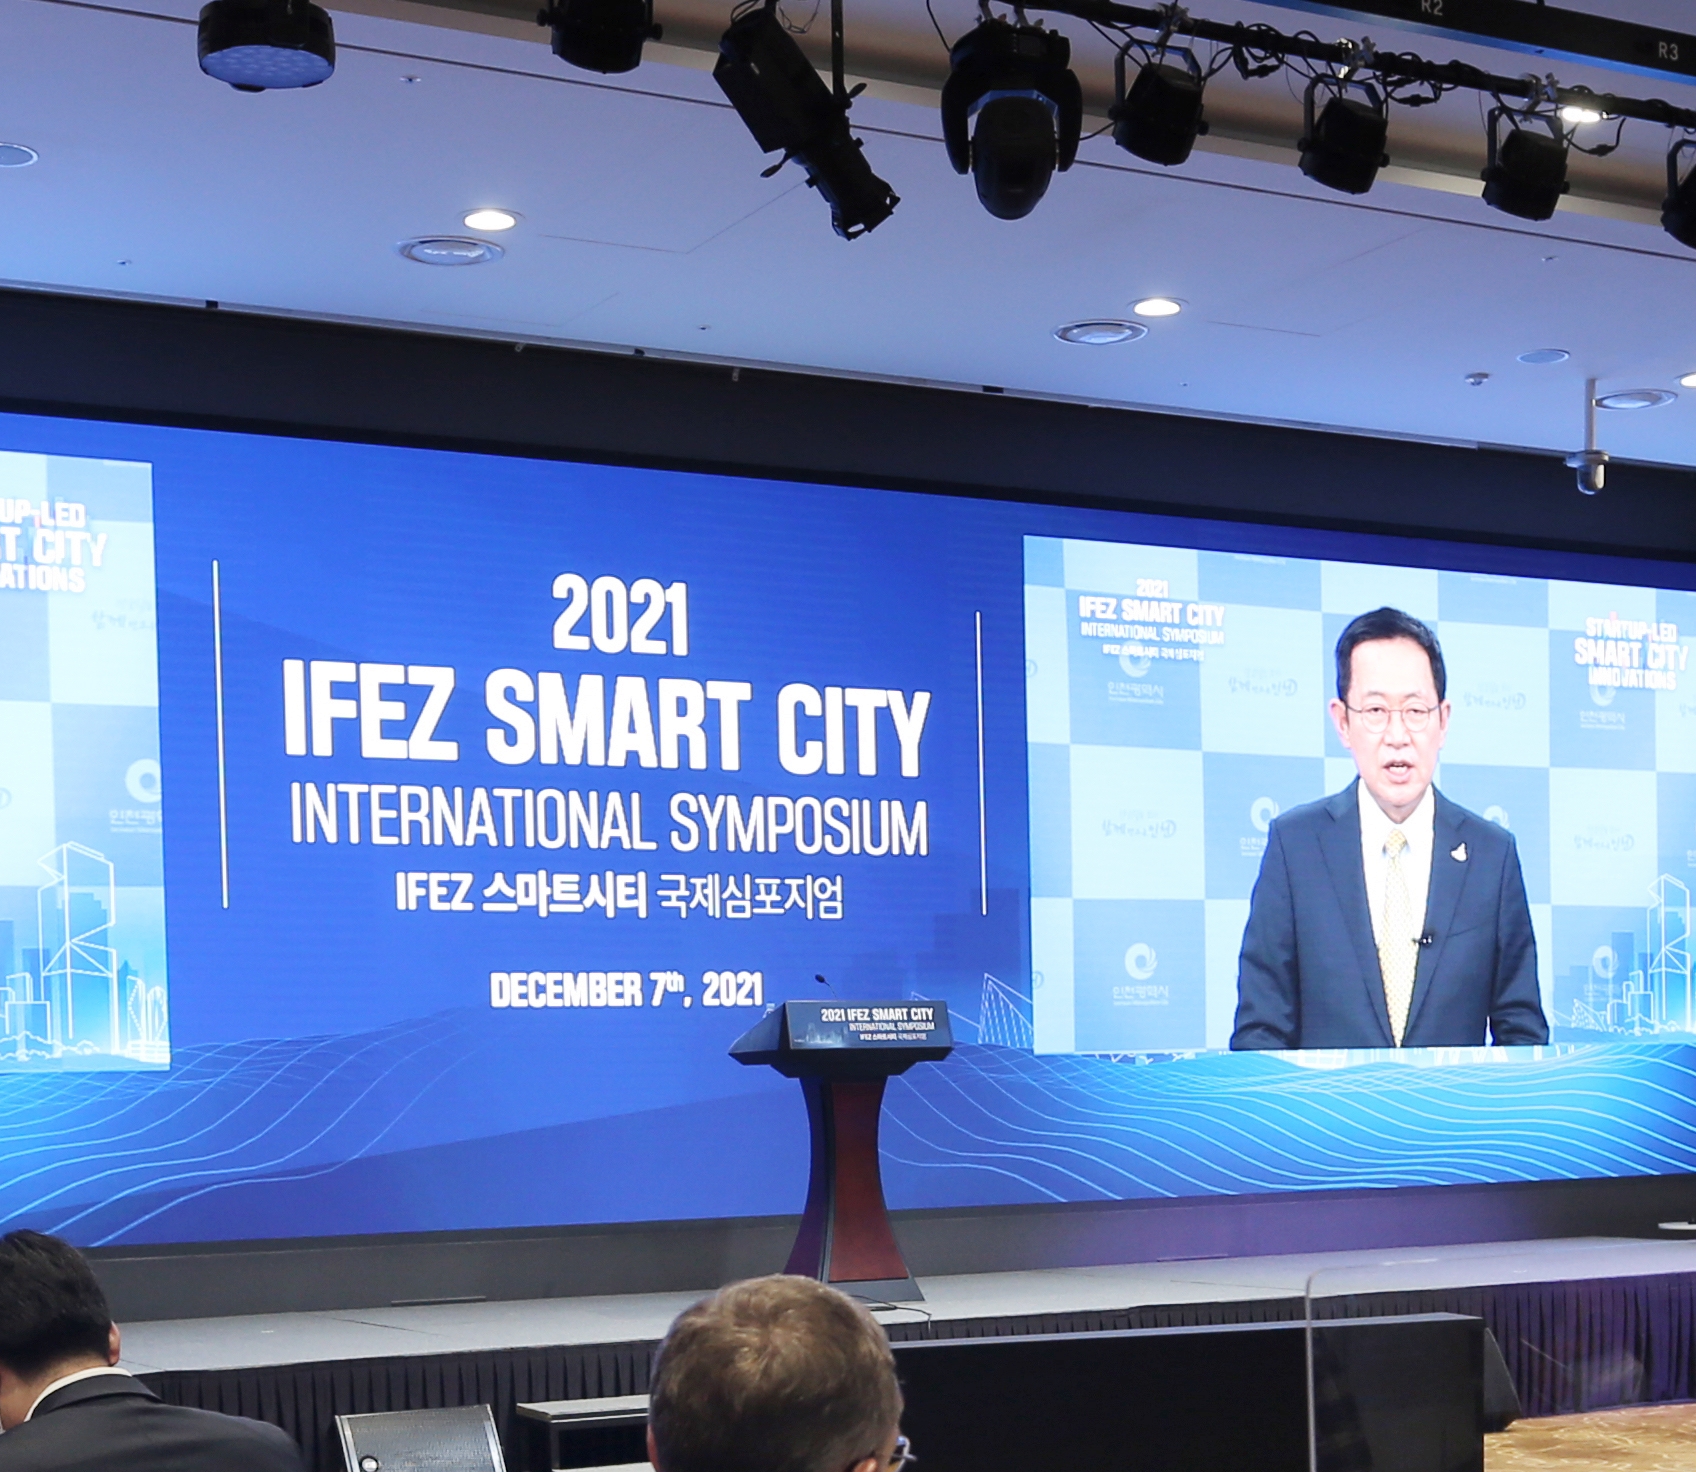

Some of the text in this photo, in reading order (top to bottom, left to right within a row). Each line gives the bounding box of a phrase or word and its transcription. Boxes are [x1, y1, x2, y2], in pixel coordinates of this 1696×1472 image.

[1421, 0, 1443, 16] R2
[1658, 41, 1679, 60] R3
[33, 528, 107, 566] CITY
[1135, 578, 1169, 598] 2021
[551, 572, 689, 657] 2021
[1078, 595, 1225, 627] IFEZ SMART CITY
[1080, 621, 1225, 645] INTERNATIONAL SYMPOSIUM
[1585, 616, 1678, 643] STARTUP-LED
[1573, 637, 1689, 671] SMART CITY
[1588, 666, 1677, 691] INNOVATIONS
[282, 658, 931, 778] IFEZ SMART CITY
[290, 782, 929, 856] INTERNATIONAL SYMPOSIUM
[395, 869, 844, 920] IFEZ 스마트시티 국제심포지엄
[489, 970, 763, 1008] DECEMBER 7th, 2021
[820, 1007, 934, 1022] 2021 IFEZ SMART CITY
